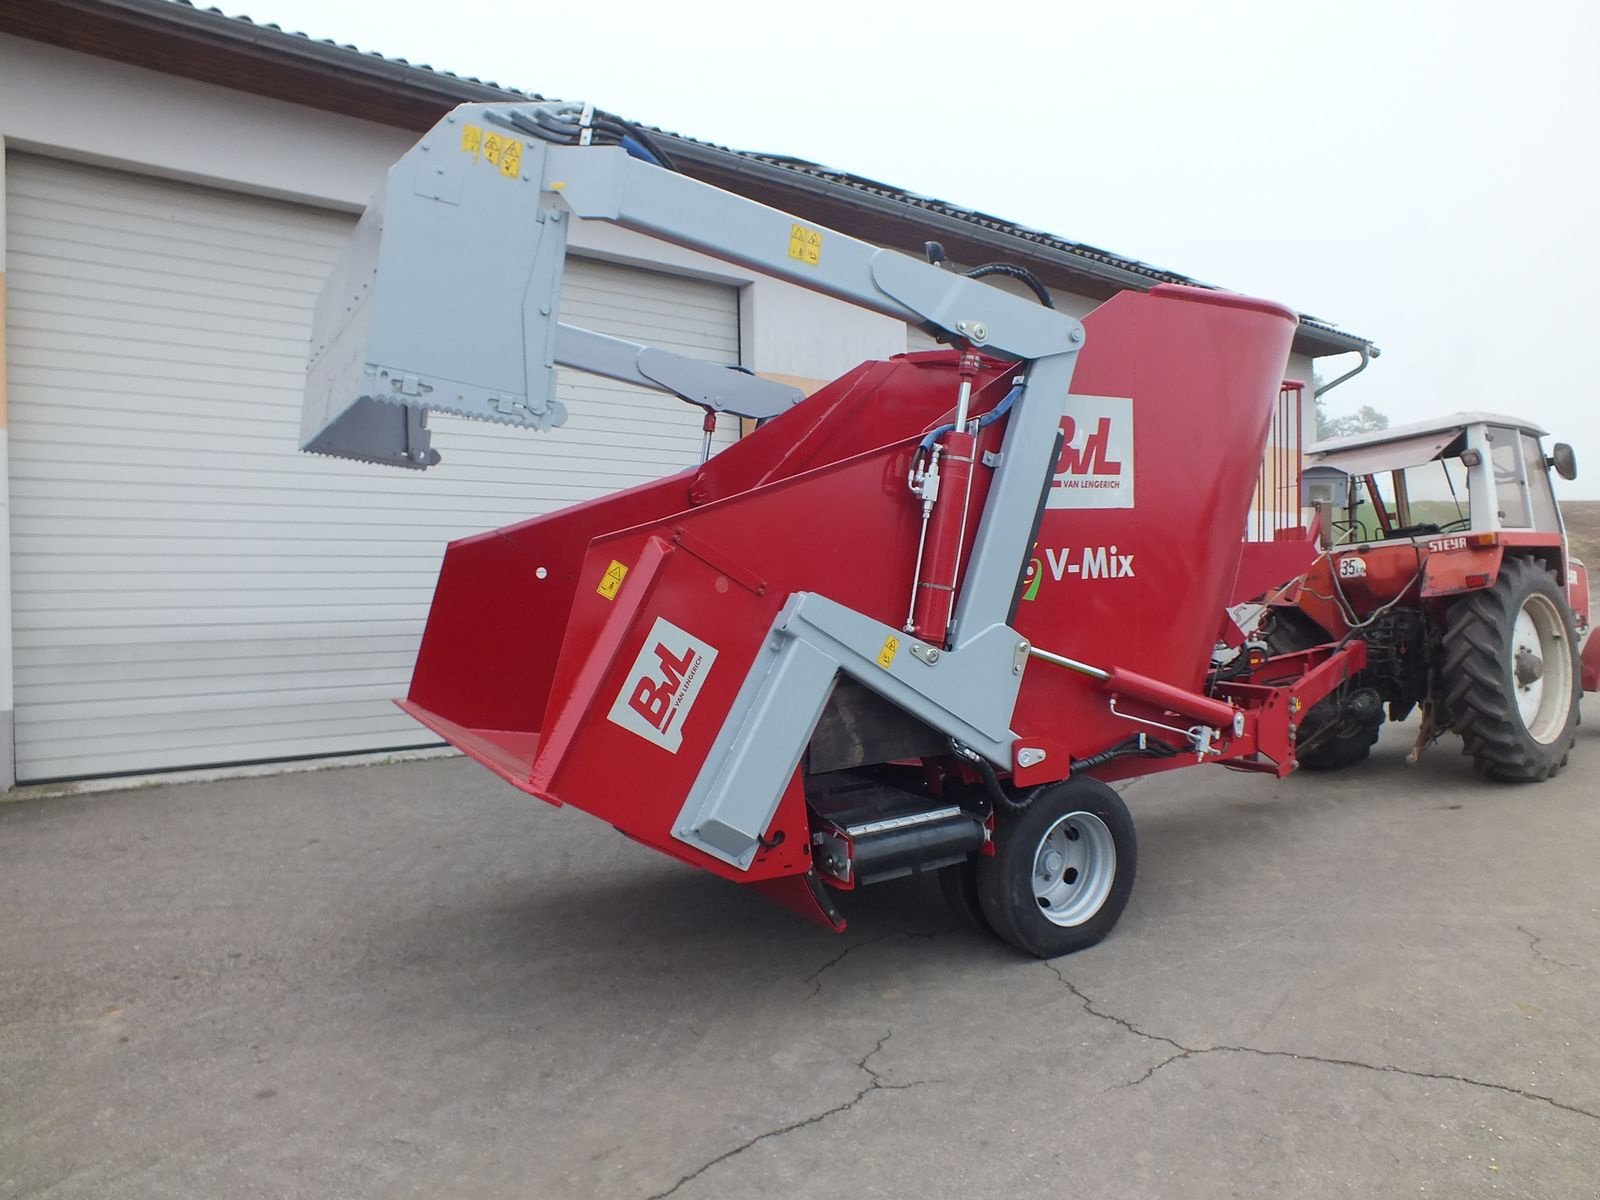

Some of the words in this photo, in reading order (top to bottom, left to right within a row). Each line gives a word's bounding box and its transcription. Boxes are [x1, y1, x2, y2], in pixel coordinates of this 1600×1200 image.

[1063, 480, 1080, 489] VAN
[1081, 480, 1120, 489] LENGERICH
[1428, 536, 1467, 553] STEYR
[1045, 545, 1136, 581] V-Mix
[1341, 559, 1356, 576] 35
[674, 690, 685, 707] VAN
[682, 655, 703, 693] LENGERICH
